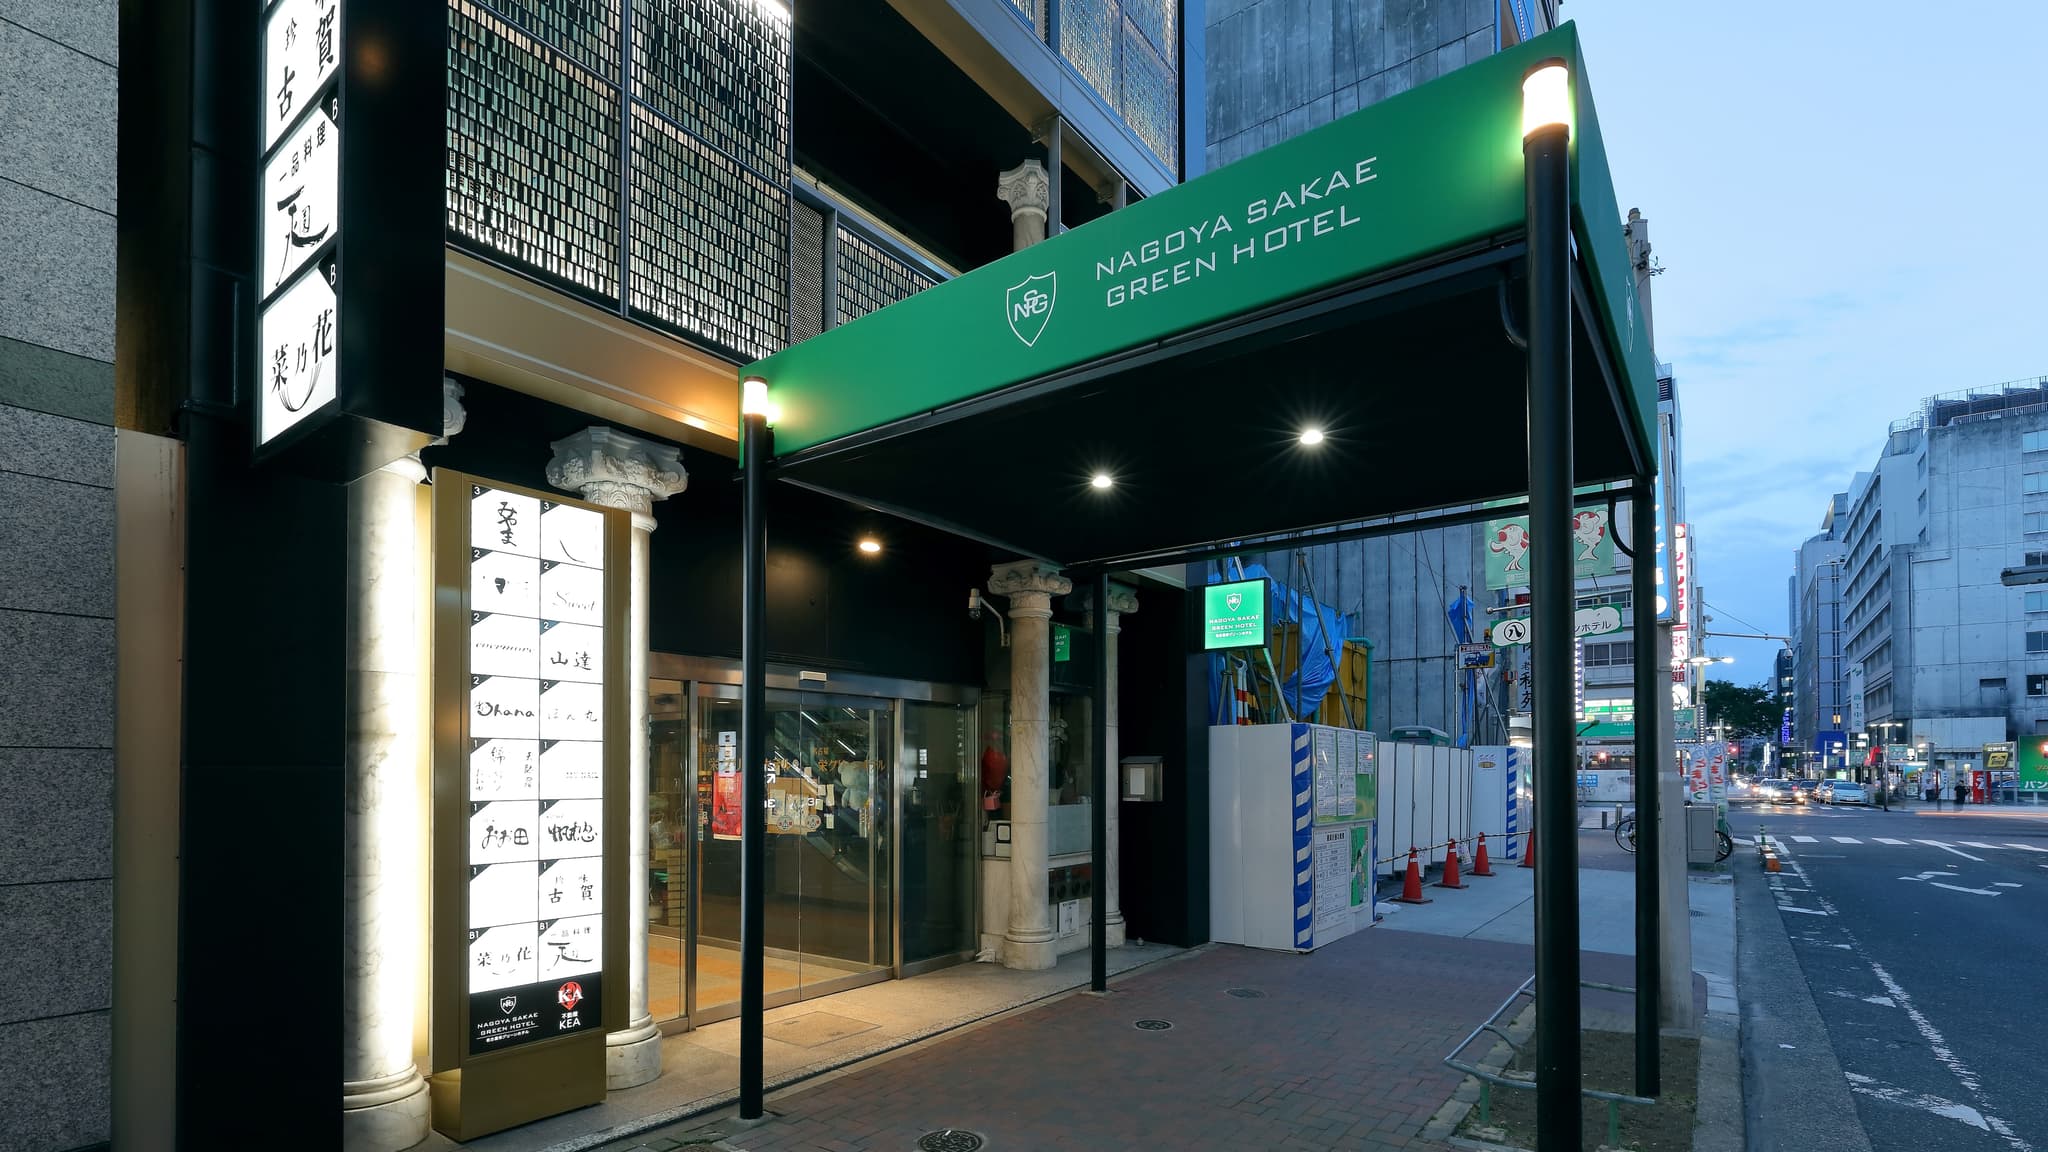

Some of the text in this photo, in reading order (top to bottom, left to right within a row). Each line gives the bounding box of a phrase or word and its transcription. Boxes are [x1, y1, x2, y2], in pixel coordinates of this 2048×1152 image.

[279, 120, 327, 182] 一品料理
[1097, 156, 1378, 281] NAGOYA SAKAE
[1106, 205, 1361, 308] GREEN HOTEL
[270, 308, 333, 393] 菜乃花
[473, 486, 481, 495] 3
[543, 501, 550, 510] 3
[473, 549, 481, 558] 2
[543, 561, 550, 570] 2
[473, 612, 480, 621] 2
[543, 621, 550, 630] 2
[473, 676, 480, 685] 2
[543, 681, 549, 690] 2
[477, 1012, 539, 1030] NAGOYA SAKAE
[559, 1018, 582, 1030] KEA
[480, 1021, 536, 1037] GREEN HOTEL
